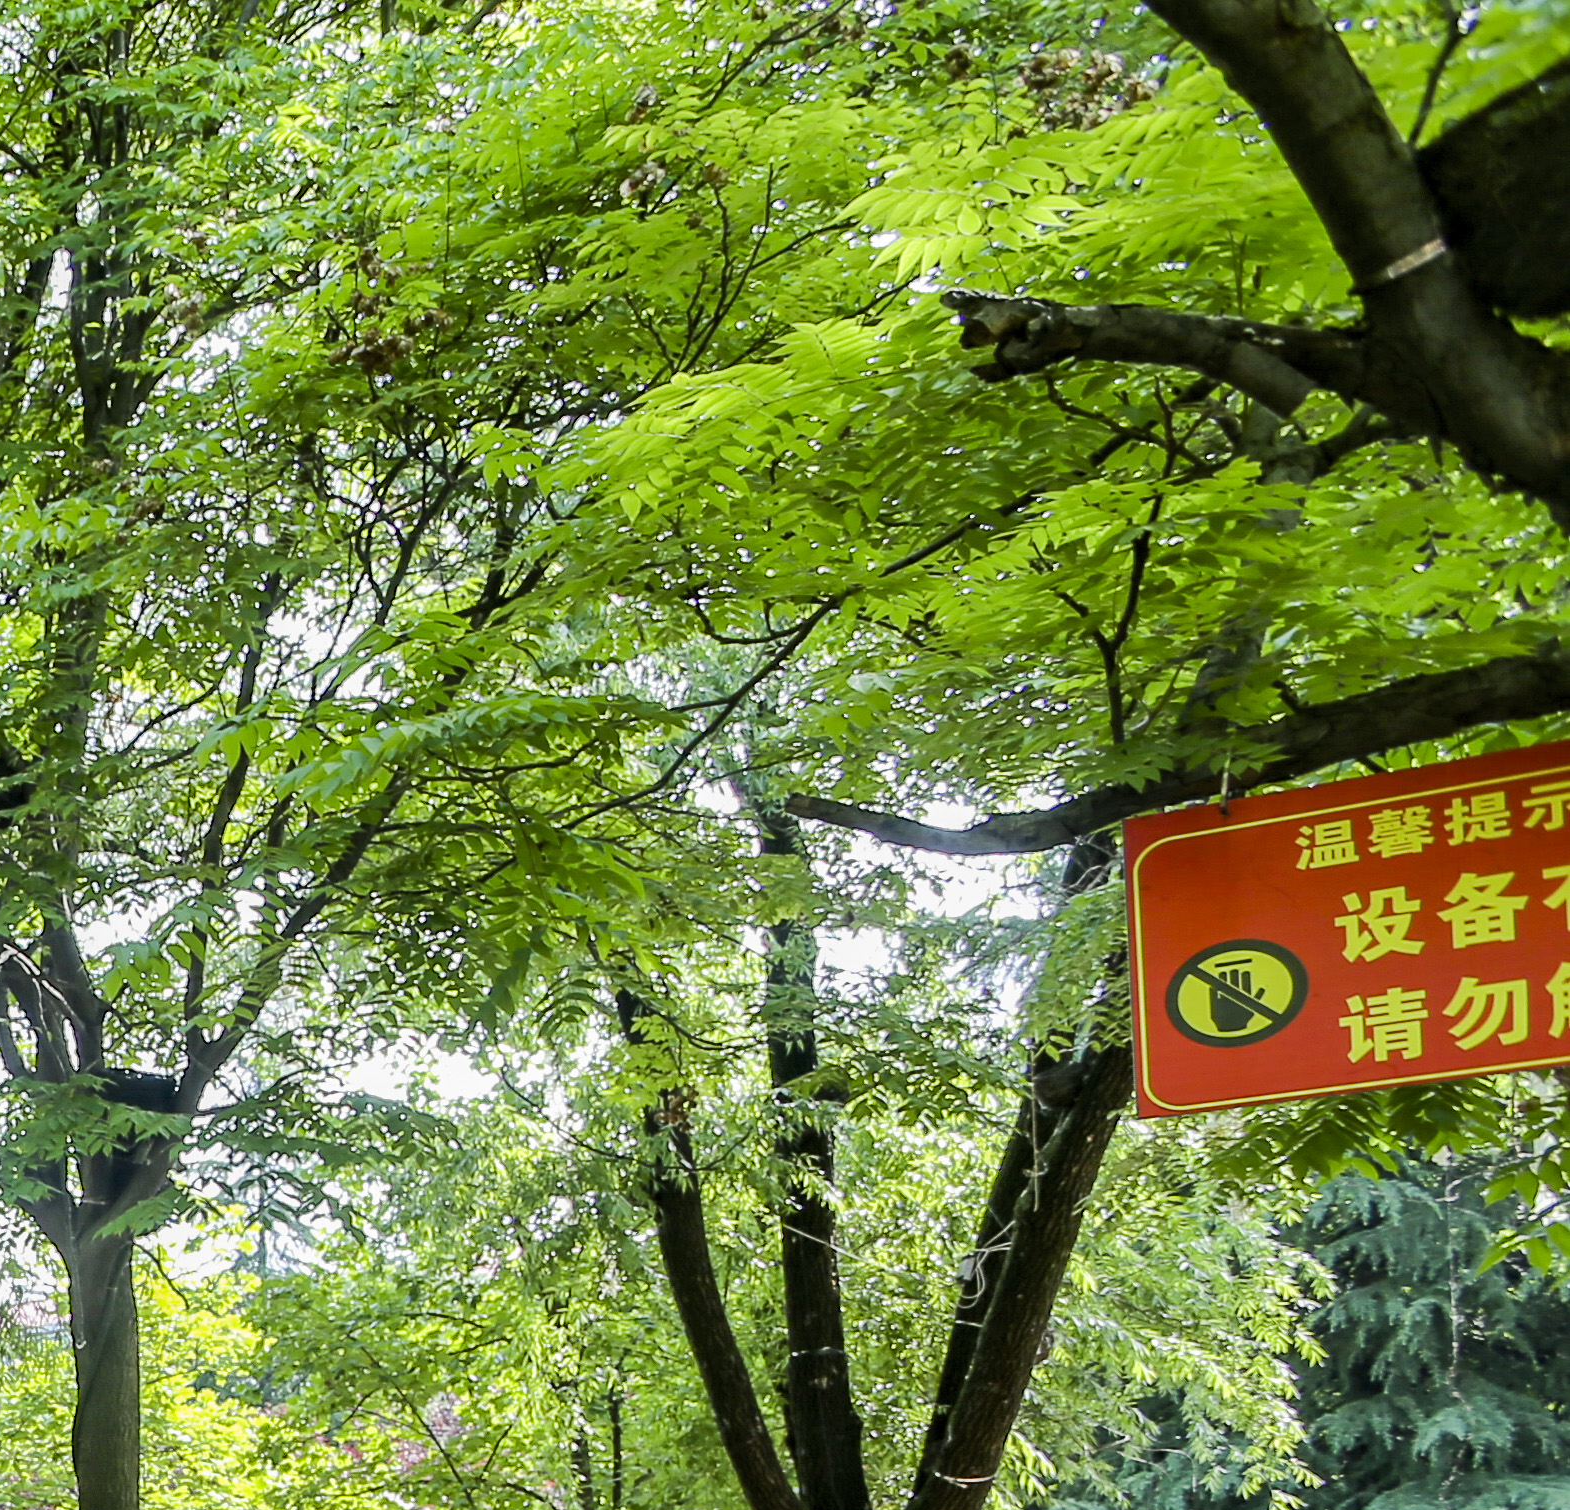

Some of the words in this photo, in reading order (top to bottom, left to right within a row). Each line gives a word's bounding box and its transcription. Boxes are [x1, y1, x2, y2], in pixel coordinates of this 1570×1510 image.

[1295, 781, 1570, 870] 温馨提示
[1339, 961, 1570, 1064] 请勿
